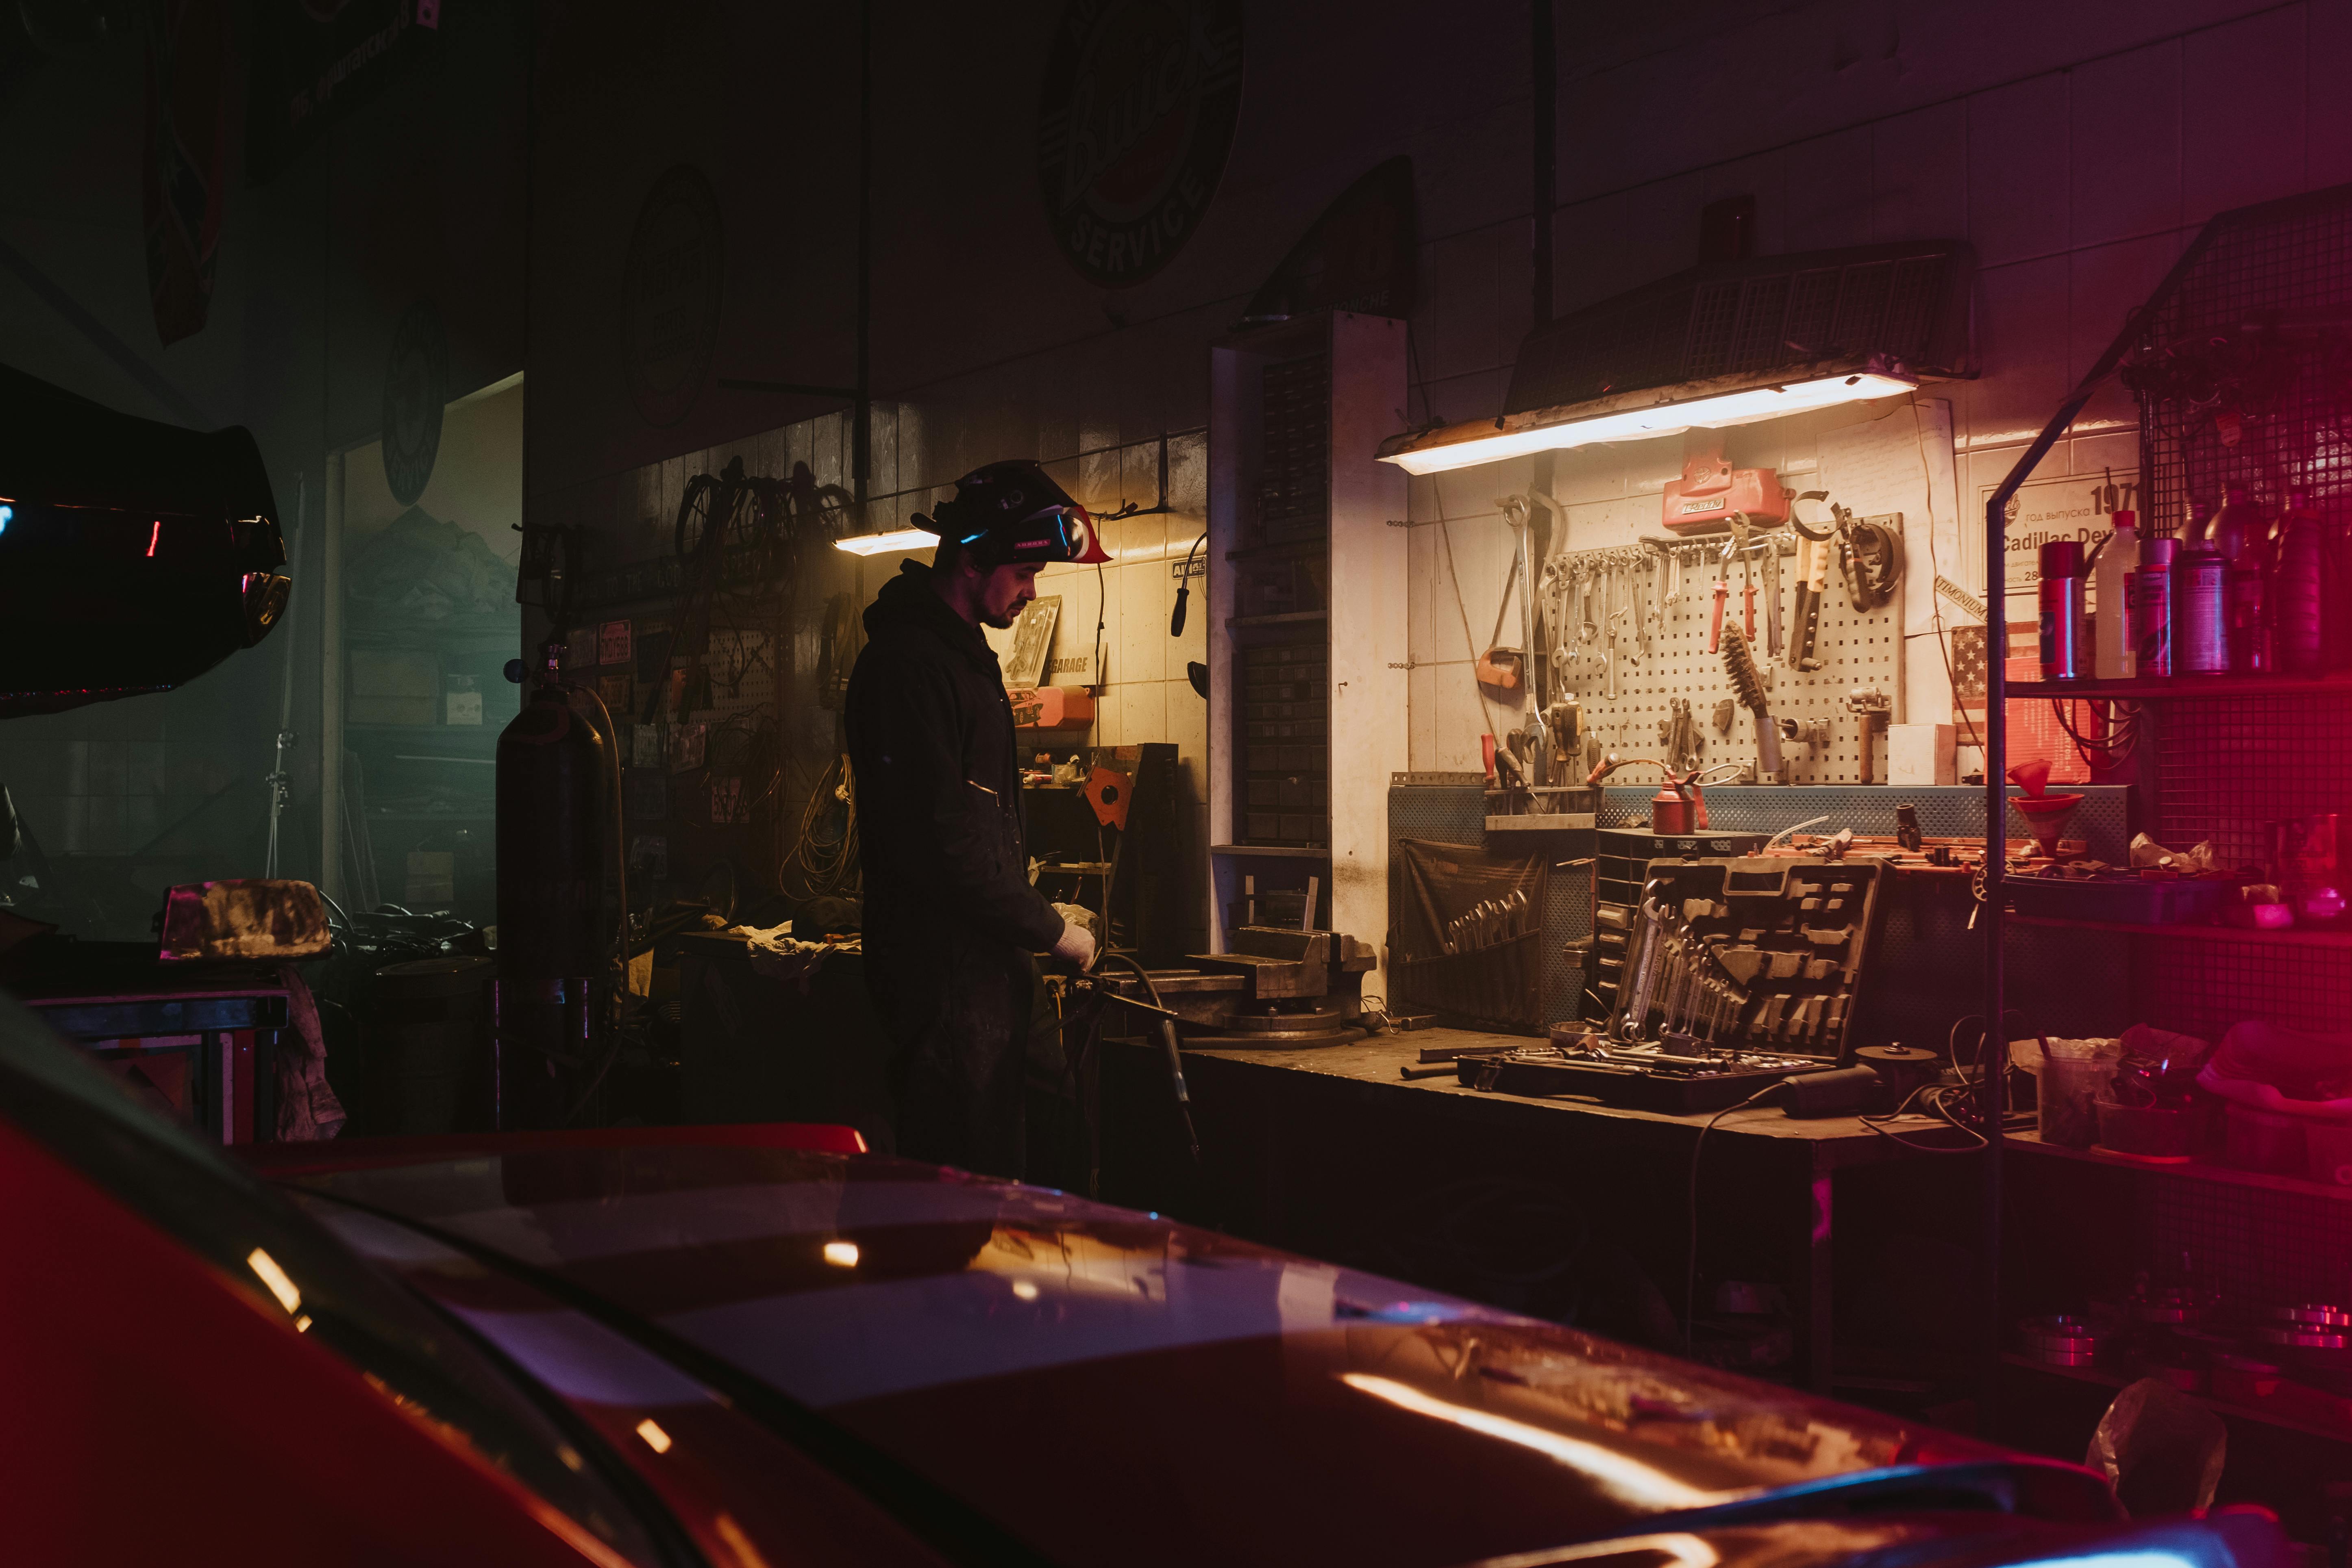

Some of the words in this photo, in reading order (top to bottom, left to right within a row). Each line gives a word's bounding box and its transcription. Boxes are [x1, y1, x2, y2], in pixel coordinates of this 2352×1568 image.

[1059, 0, 1224, 217] Buick
[1070, 166, 1206, 272] SERVICE
[679, 318, 713, 406] PRODUCTS
[2026, 513, 2043, 522] год
[2046, 508, 2091, 520] выпуска
[1937, 578, 1988, 616] TIMONIUM
